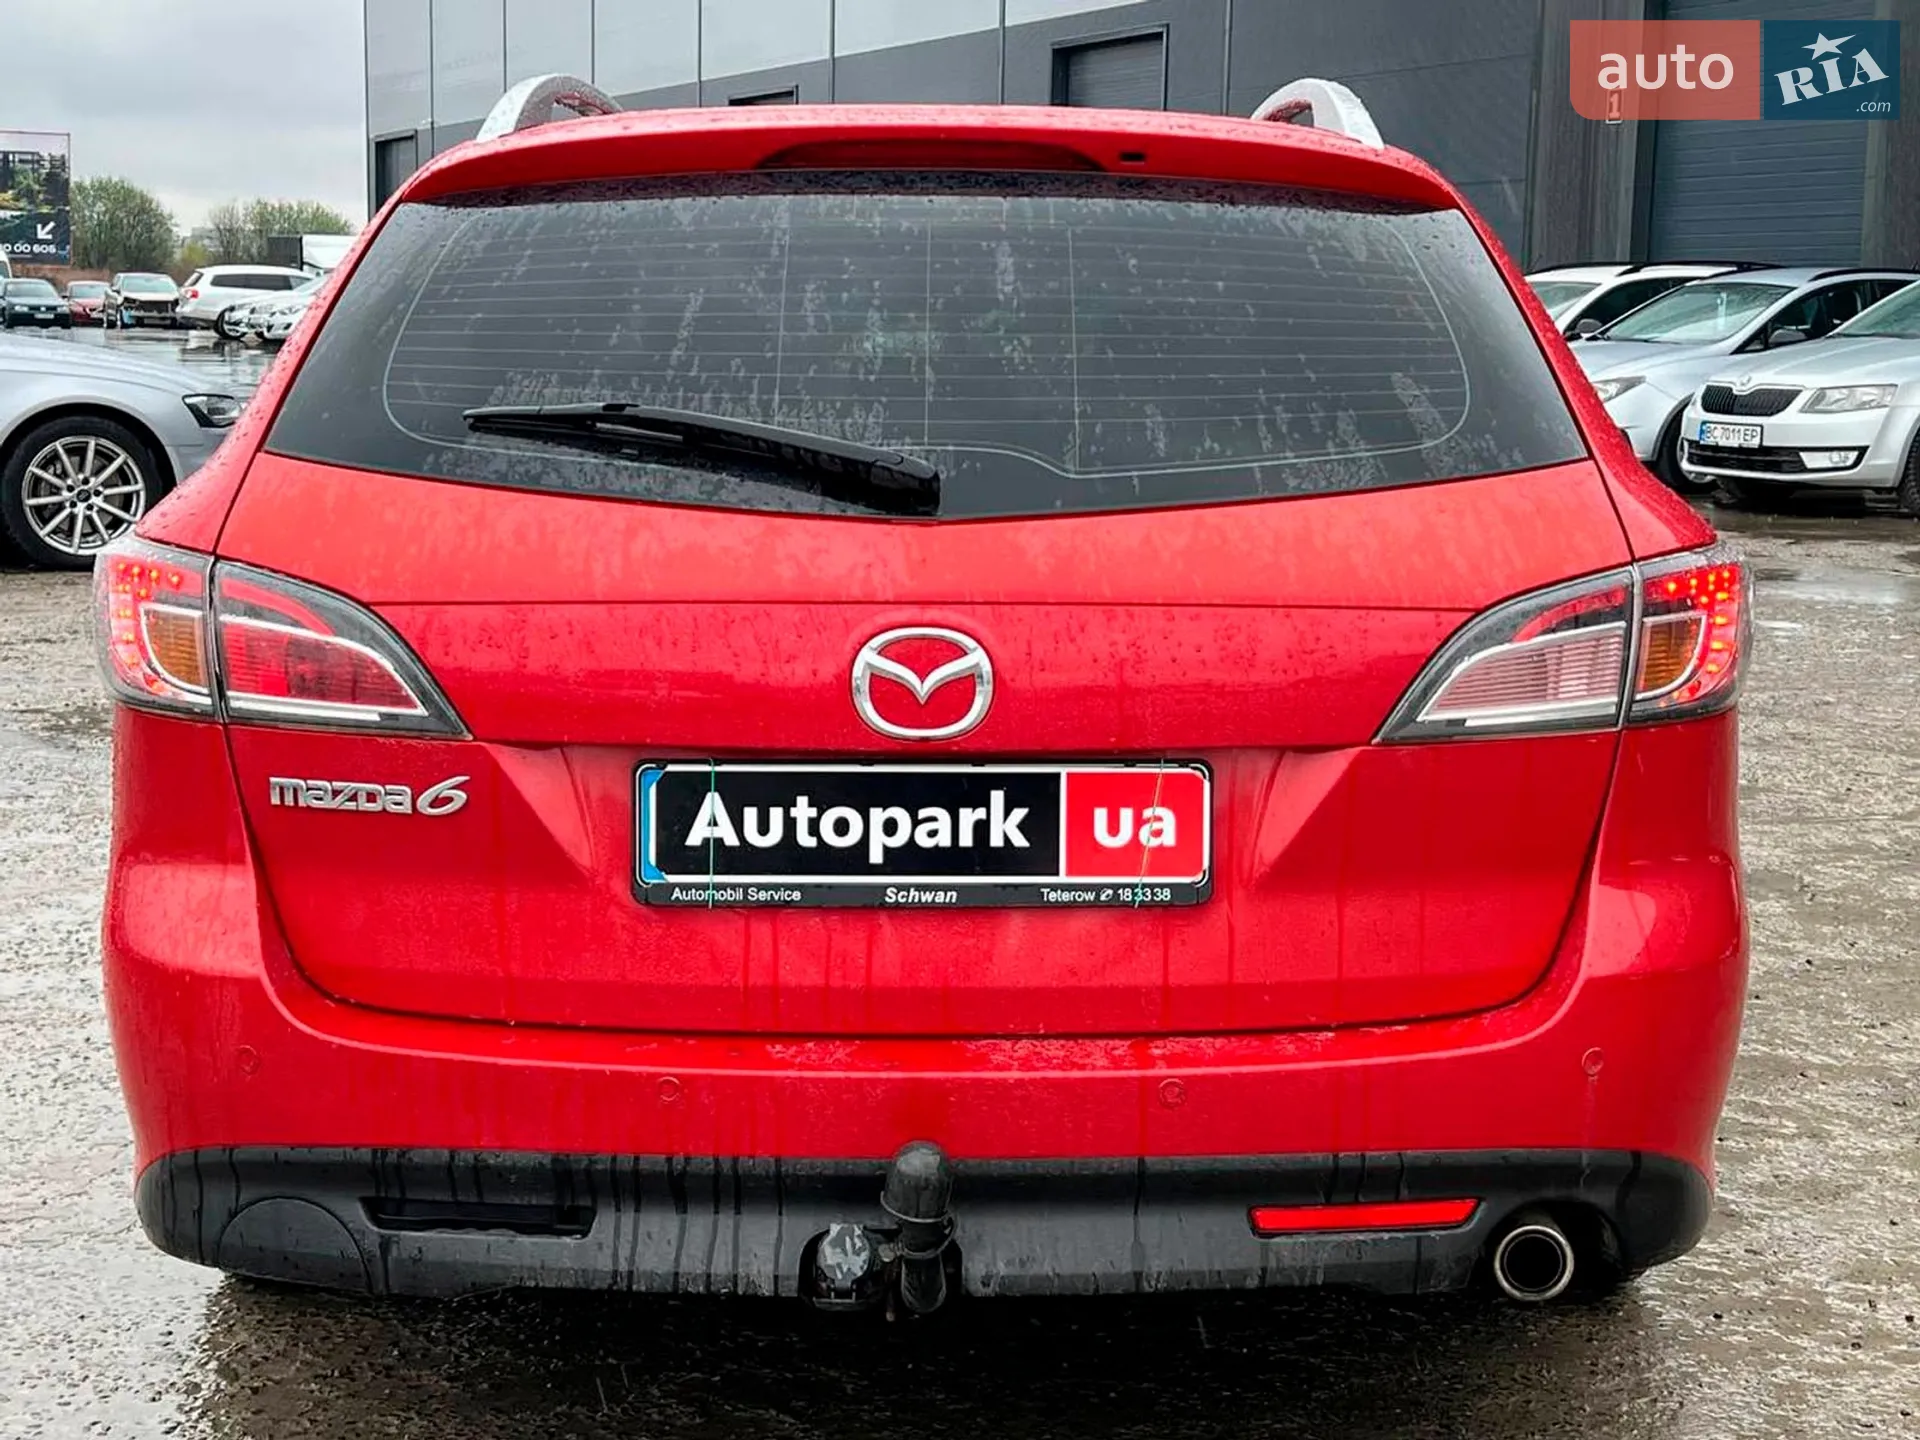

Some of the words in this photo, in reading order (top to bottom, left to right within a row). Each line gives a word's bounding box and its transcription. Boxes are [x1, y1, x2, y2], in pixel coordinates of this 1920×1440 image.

[1743, 428, 1758, 441] EP
[685, 789, 1030, 864] Autopark
[1093, 806, 1176, 849] ua
[671, 887, 743, 901] Automobil
[747, 887, 801, 901] Service
[884, 887, 958, 903] Schwan
[1040, 888, 1096, 902] Teterow
